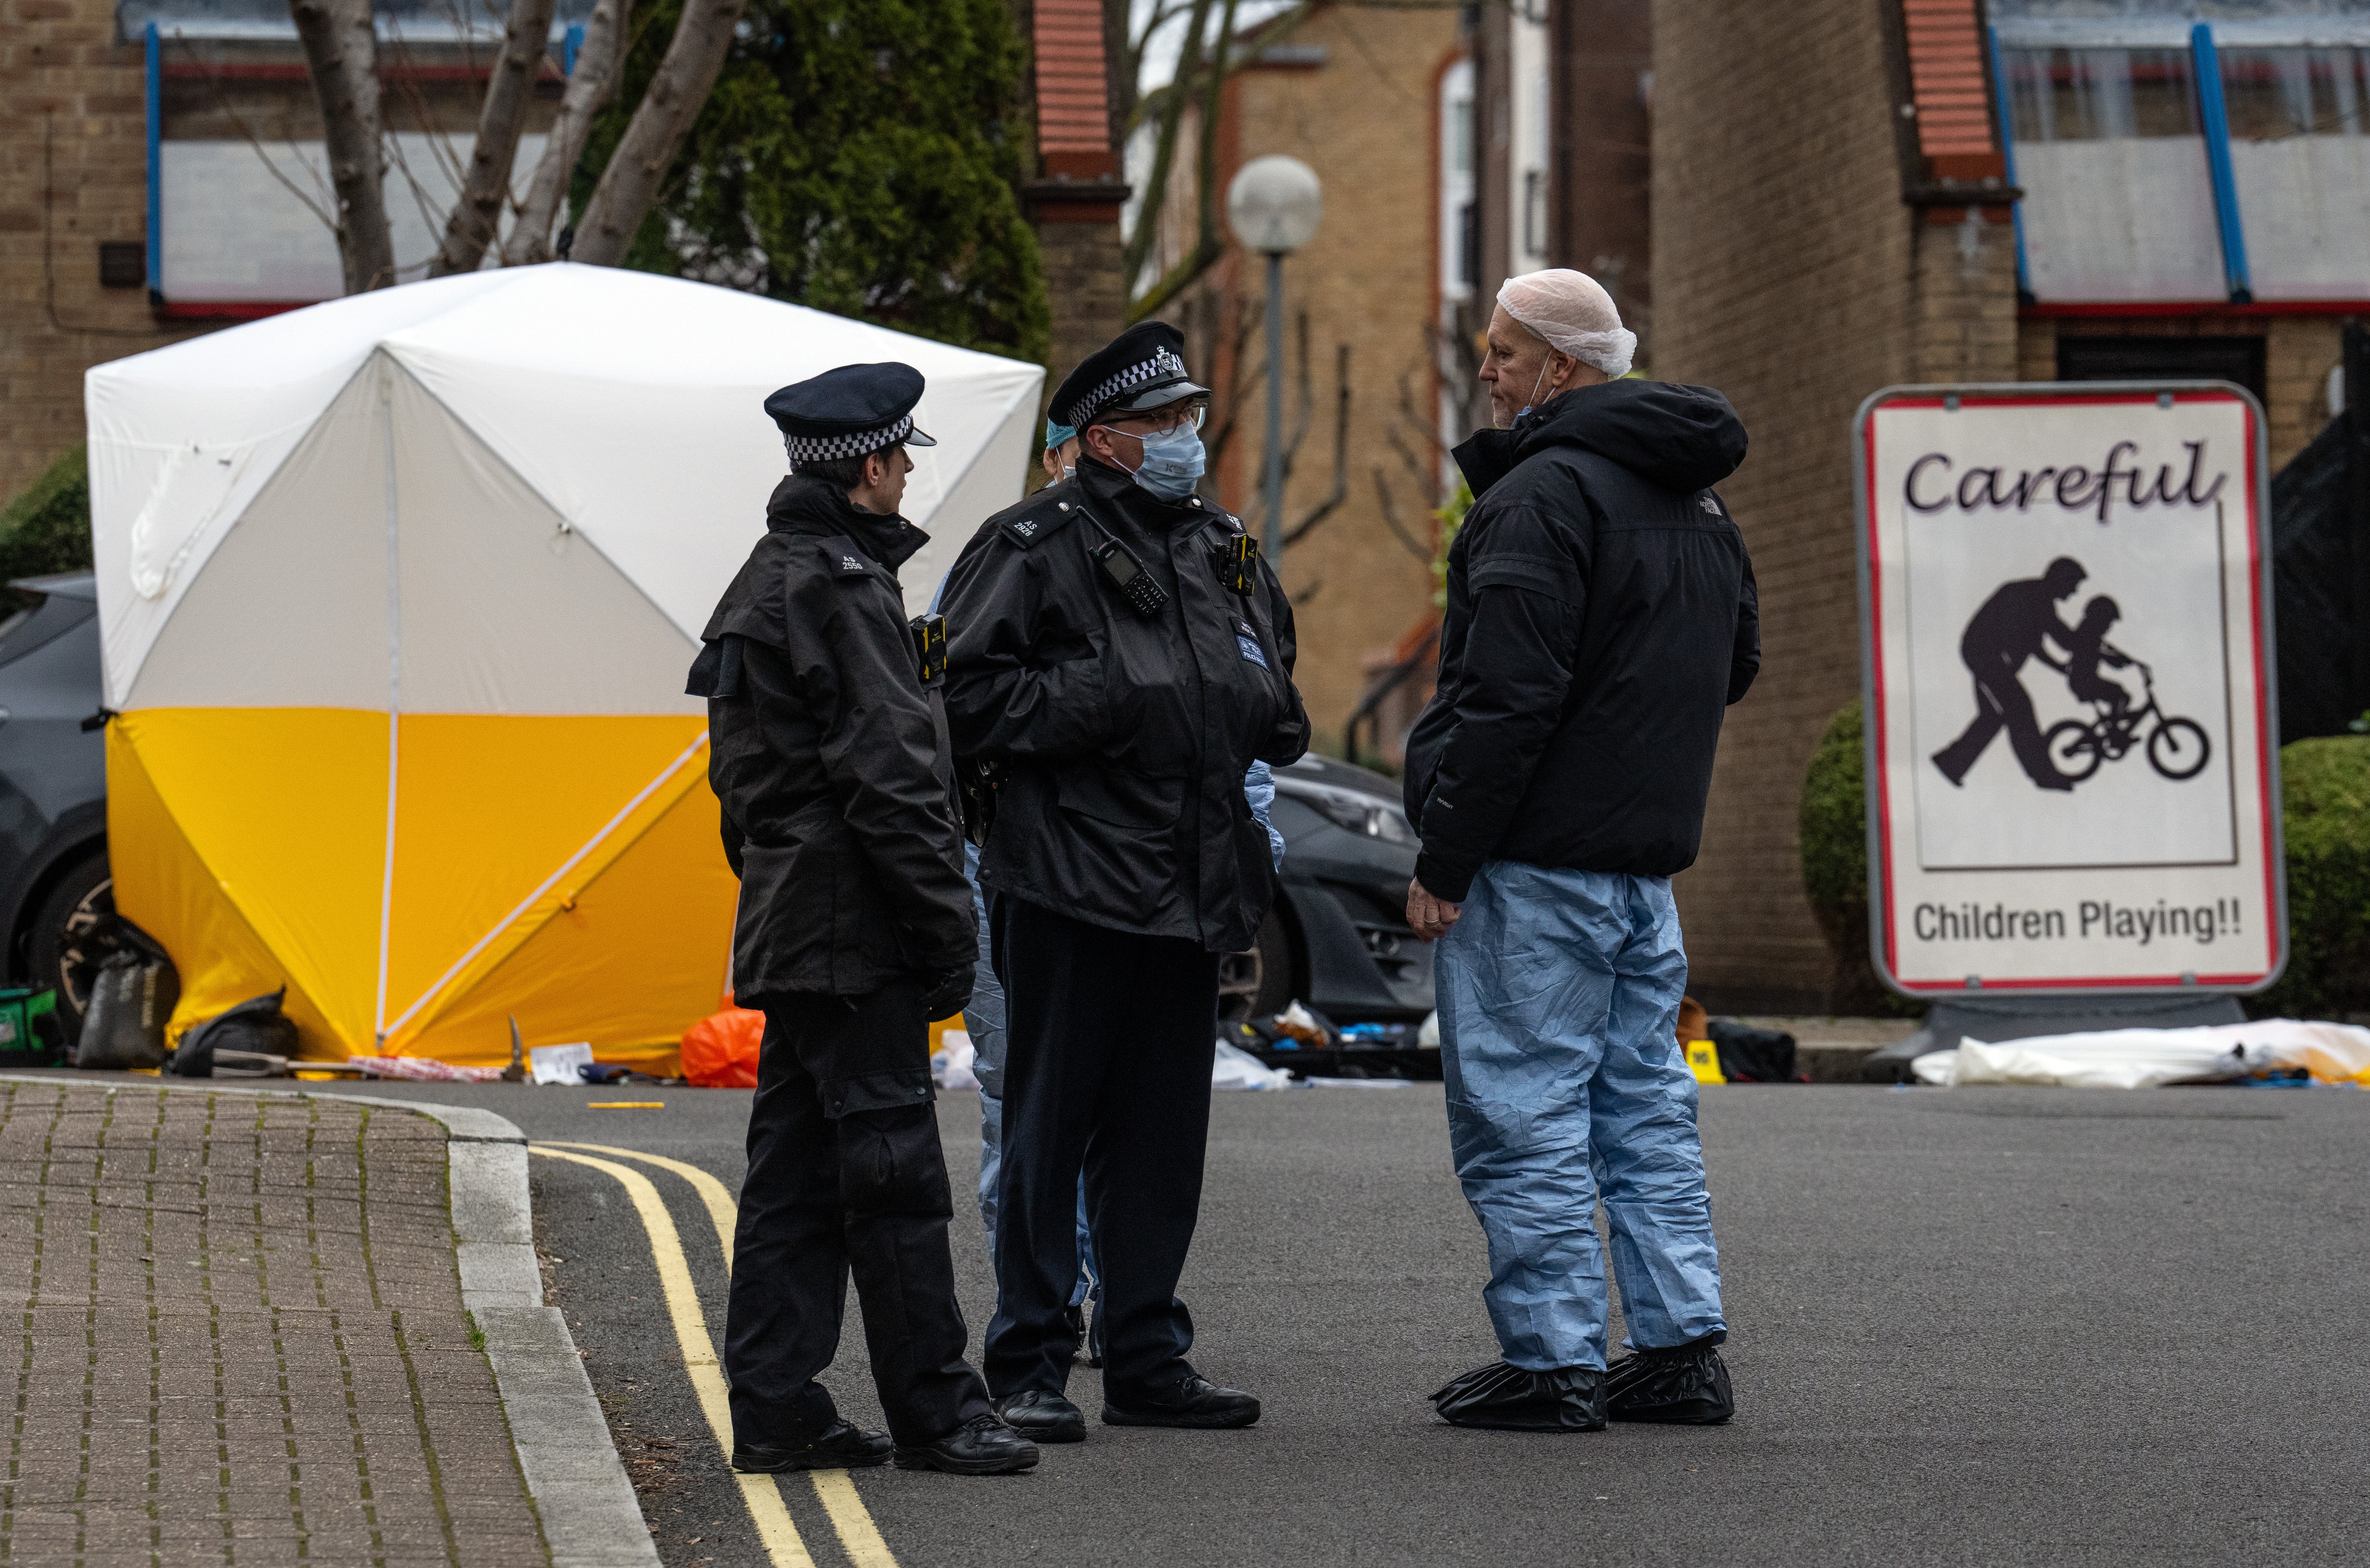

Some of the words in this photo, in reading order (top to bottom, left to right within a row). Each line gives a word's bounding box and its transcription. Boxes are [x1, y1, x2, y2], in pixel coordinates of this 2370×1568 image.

[1904, 440, 2227, 524] Careful
[1014, 523, 1033, 536] 2928
[1024, 521, 1037, 529] AS
[1243, 651, 1258, 660] POLICE
[1914, 903, 2066, 941] Children
[2079, 898, 2242, 947] Playing!!
